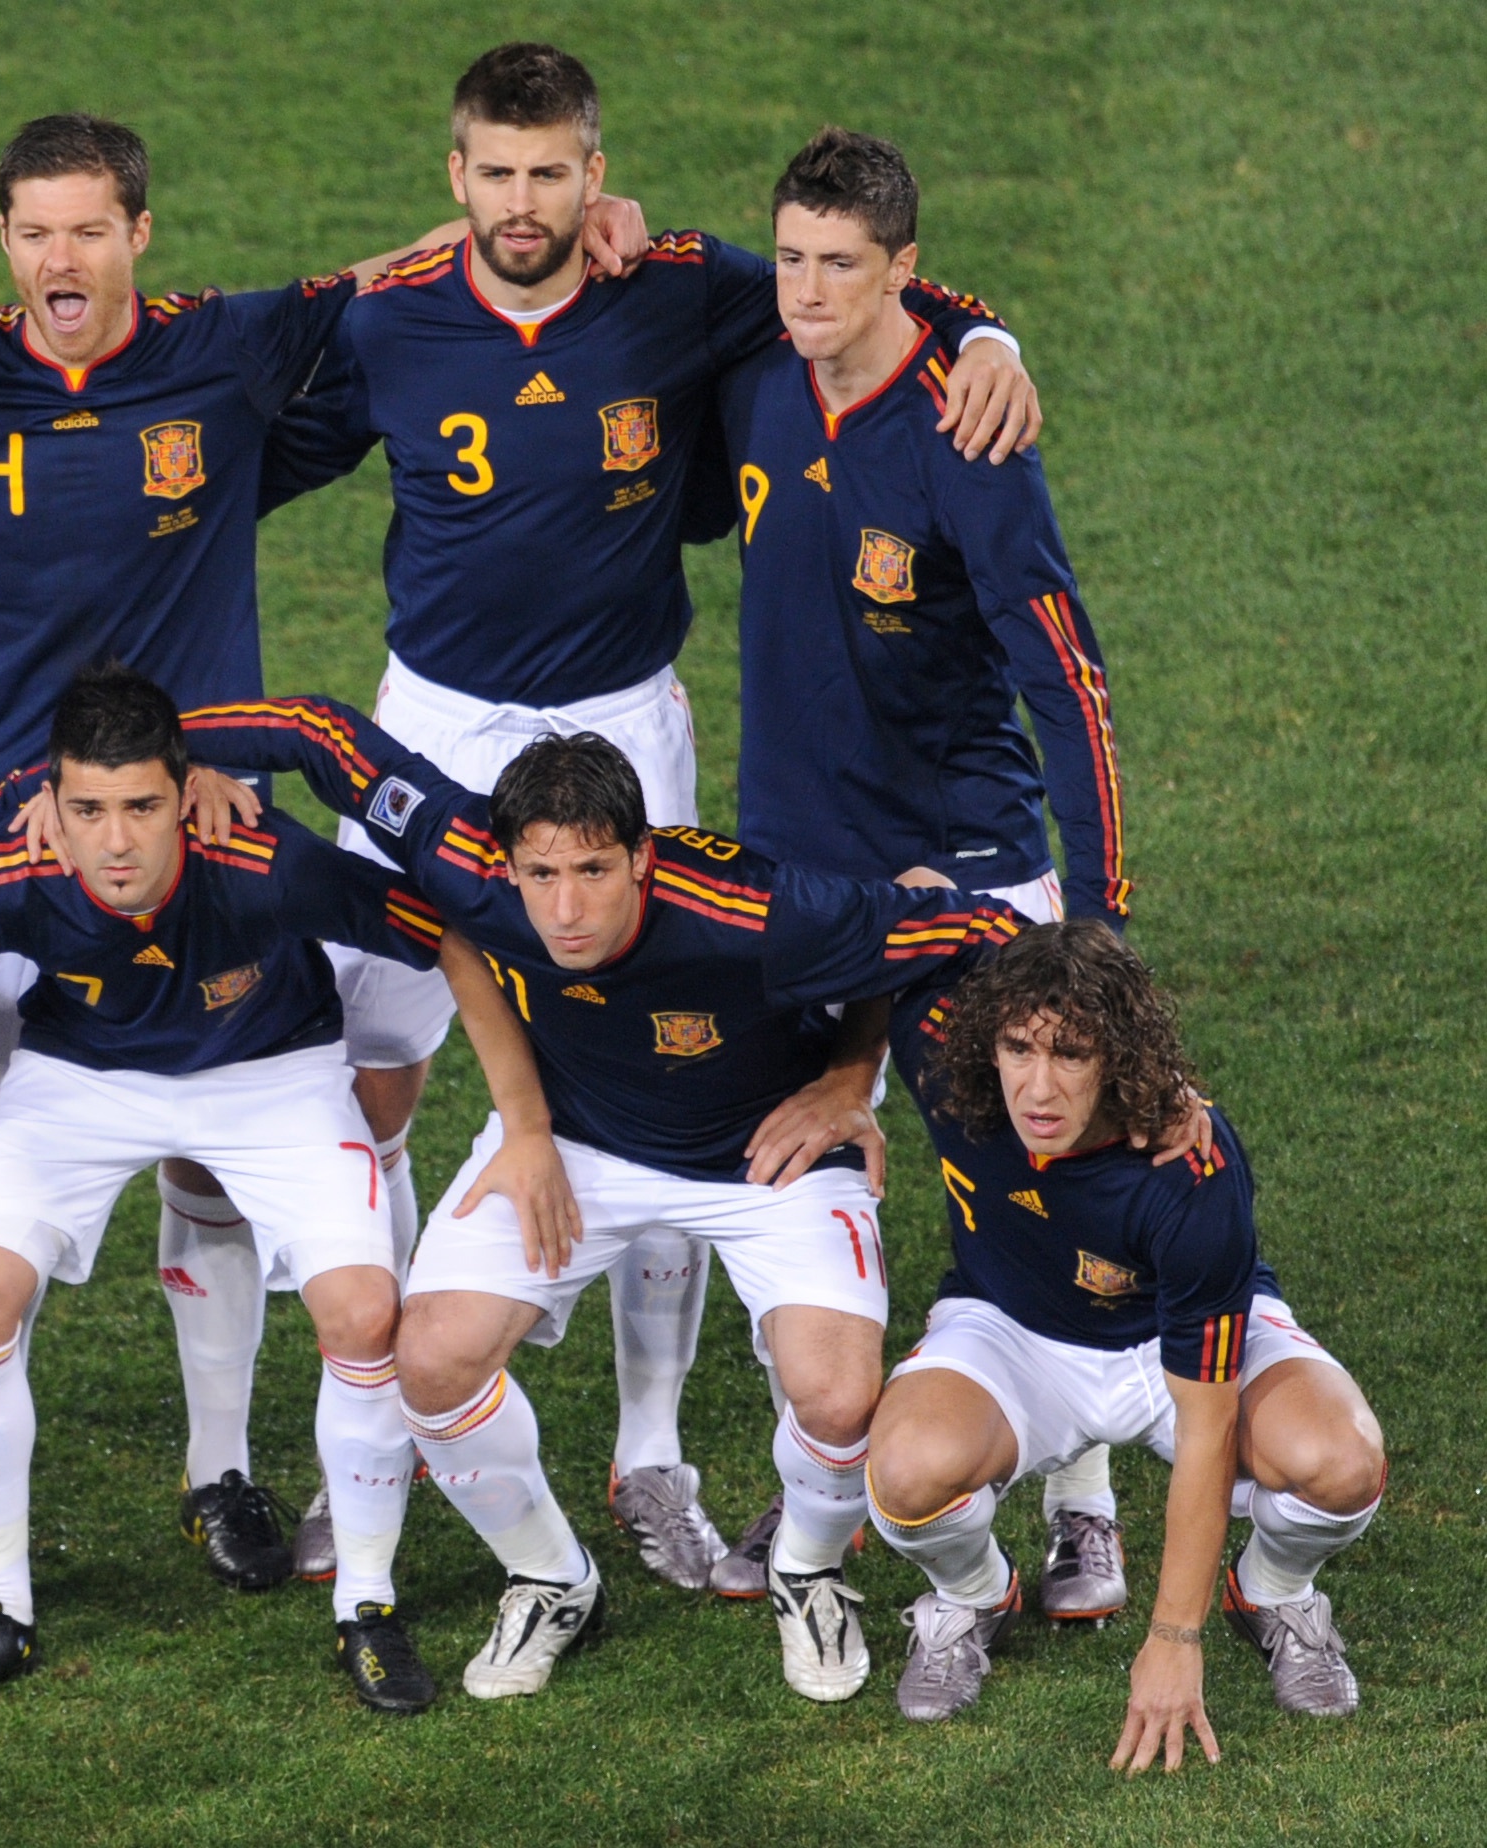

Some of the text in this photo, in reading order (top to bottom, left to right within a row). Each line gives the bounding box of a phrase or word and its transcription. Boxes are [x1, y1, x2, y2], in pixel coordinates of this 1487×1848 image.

[515, 391, 566, 406] adidas
[52, 416, 100, 430] adidas
[439, 412, 494, 496] 3
[739, 463, 770, 545] 9
[57, 972, 103, 1006] 7
[561, 988, 606, 1005] adidas
[338, 1141, 377, 1210] 7
[1008, 1193, 1049, 1219] adidas
[831, 1209, 886, 1289] 11
